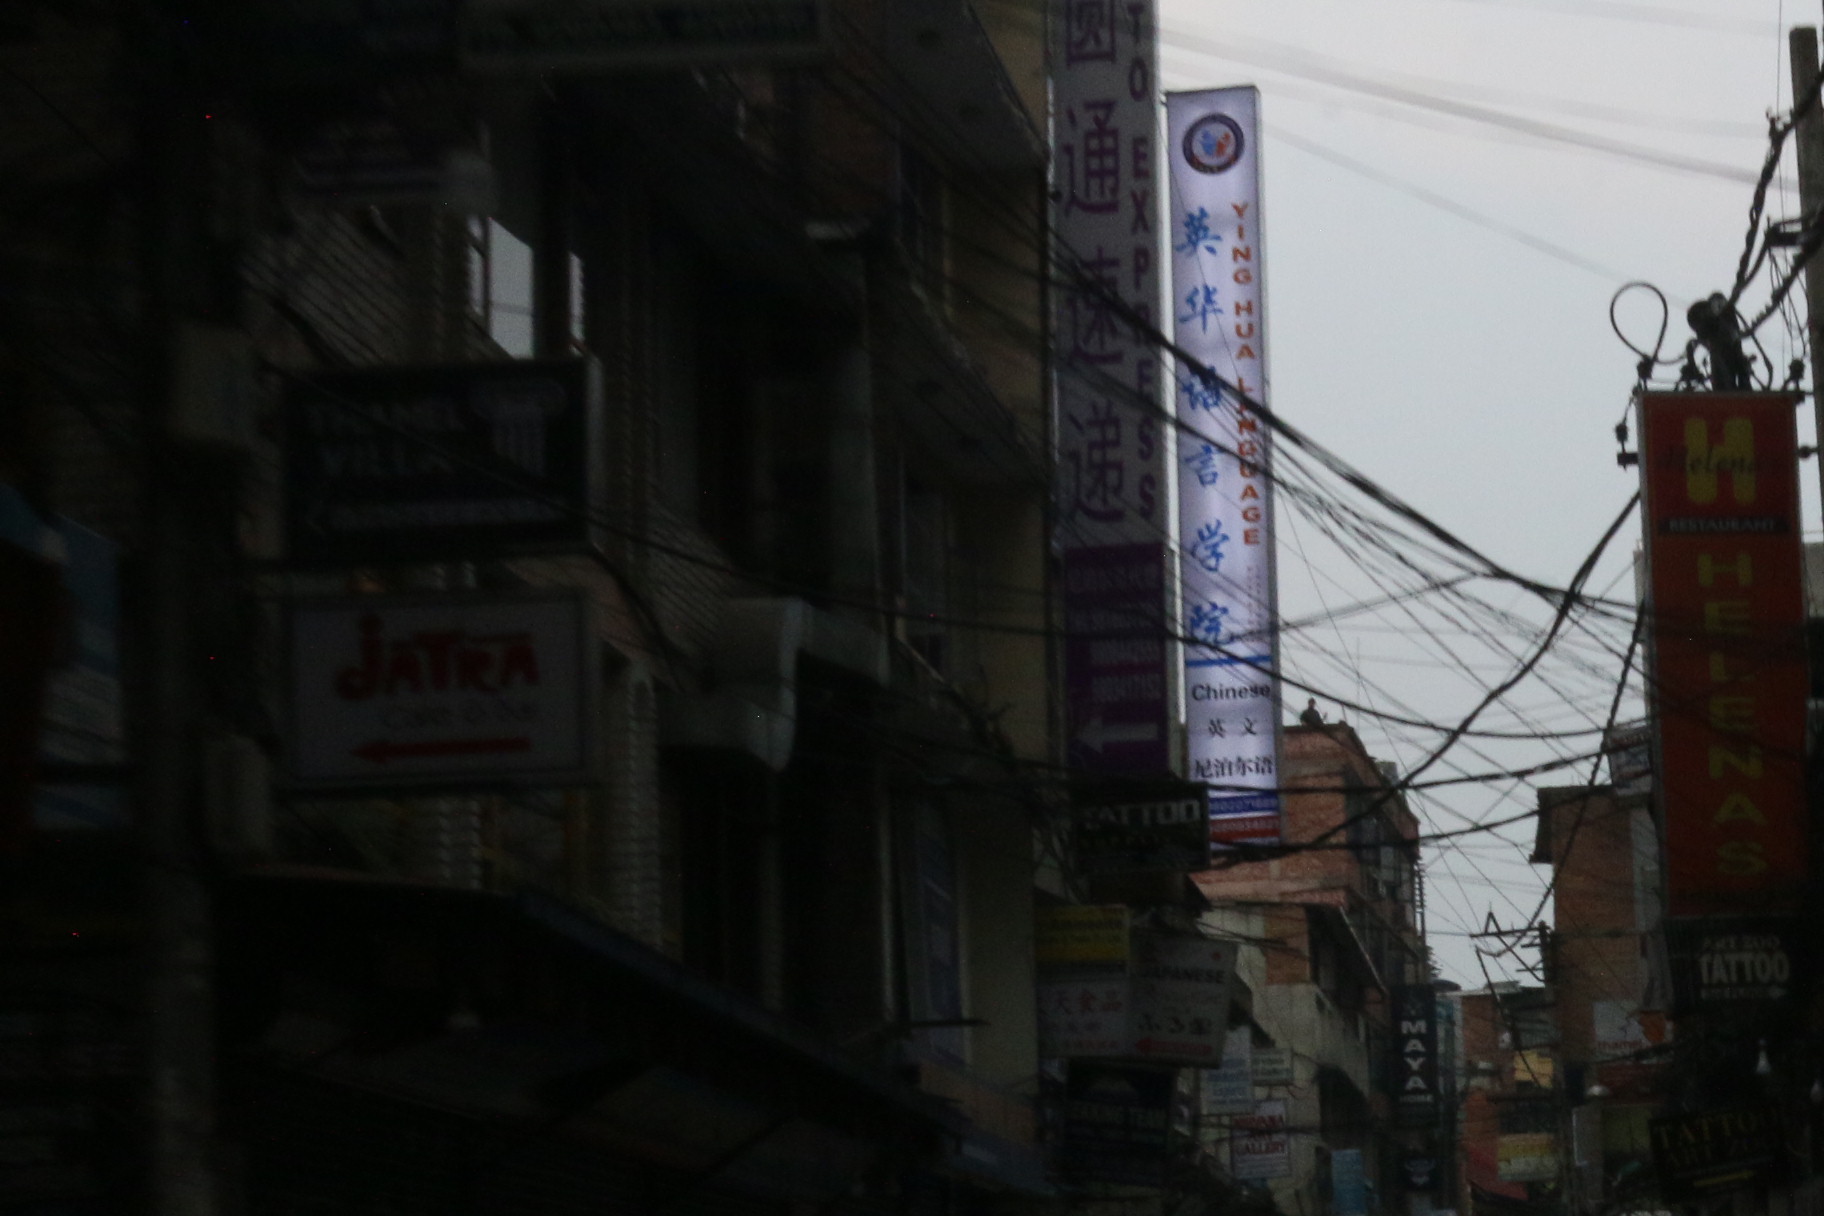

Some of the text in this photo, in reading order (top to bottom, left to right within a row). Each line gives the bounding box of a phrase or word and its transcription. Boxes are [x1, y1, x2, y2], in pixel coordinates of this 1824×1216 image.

[1696, 552, 1768, 876] HELENAS
[1698, 949, 1791, 984] TATTOO
[1400, 1019, 1428, 1091] MAYA
